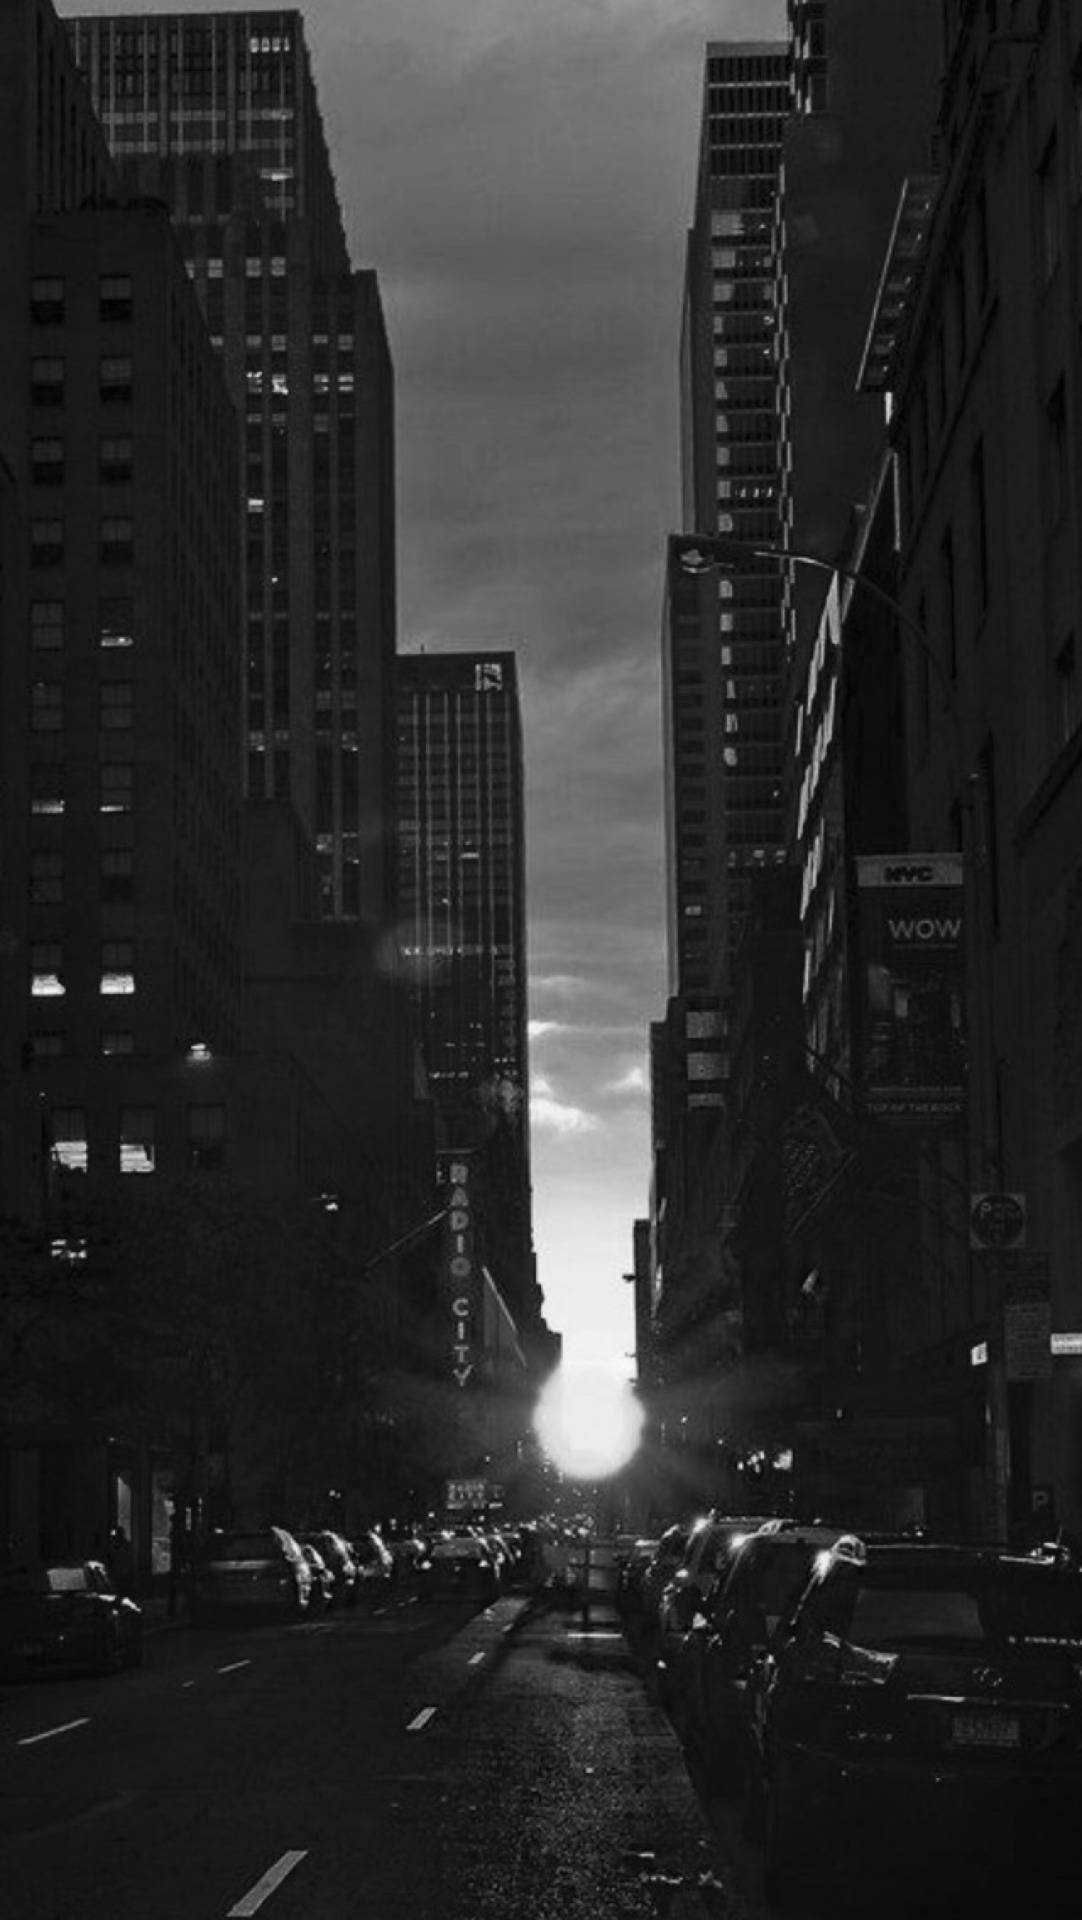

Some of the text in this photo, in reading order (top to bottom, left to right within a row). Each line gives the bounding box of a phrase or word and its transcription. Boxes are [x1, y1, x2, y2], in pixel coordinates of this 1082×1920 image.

[884, 865, 933, 883] NYC
[888, 918, 962, 940] WOW
[450, 1163, 473, 1388] RADIO CITY
[1032, 1489, 1049, 1513] P
